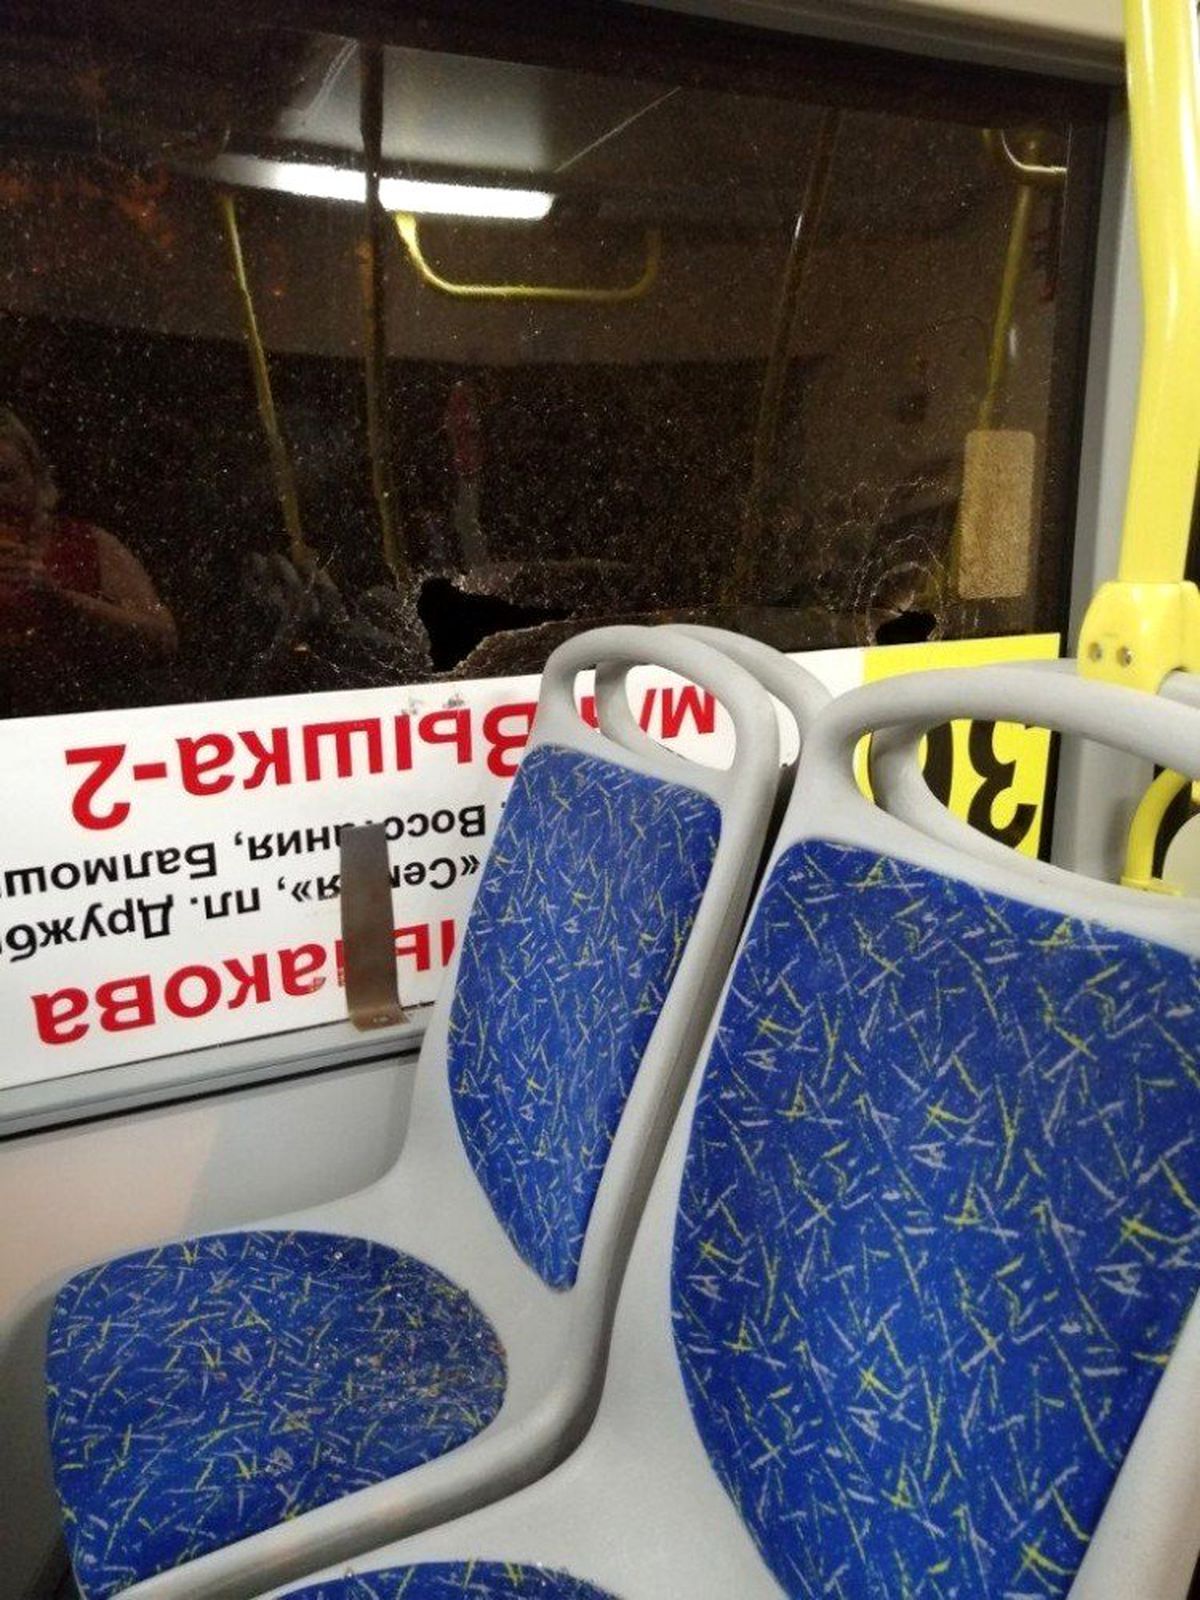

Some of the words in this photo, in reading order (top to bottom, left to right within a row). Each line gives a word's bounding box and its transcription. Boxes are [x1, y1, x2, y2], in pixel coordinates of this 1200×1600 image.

[64, 701, 538, 831] Вышка-2
[918, 720, 1038, 849] 3
[235, 804, 486, 860] Воссния,
[0, 842, 218, 897] Балмош
[276, 854, 481, 902] «Сея»,
[0, 894, 174, 963] Дружб
[189, 887, 261, 920] пл.
[30, 918, 456, 1045] ьакова
